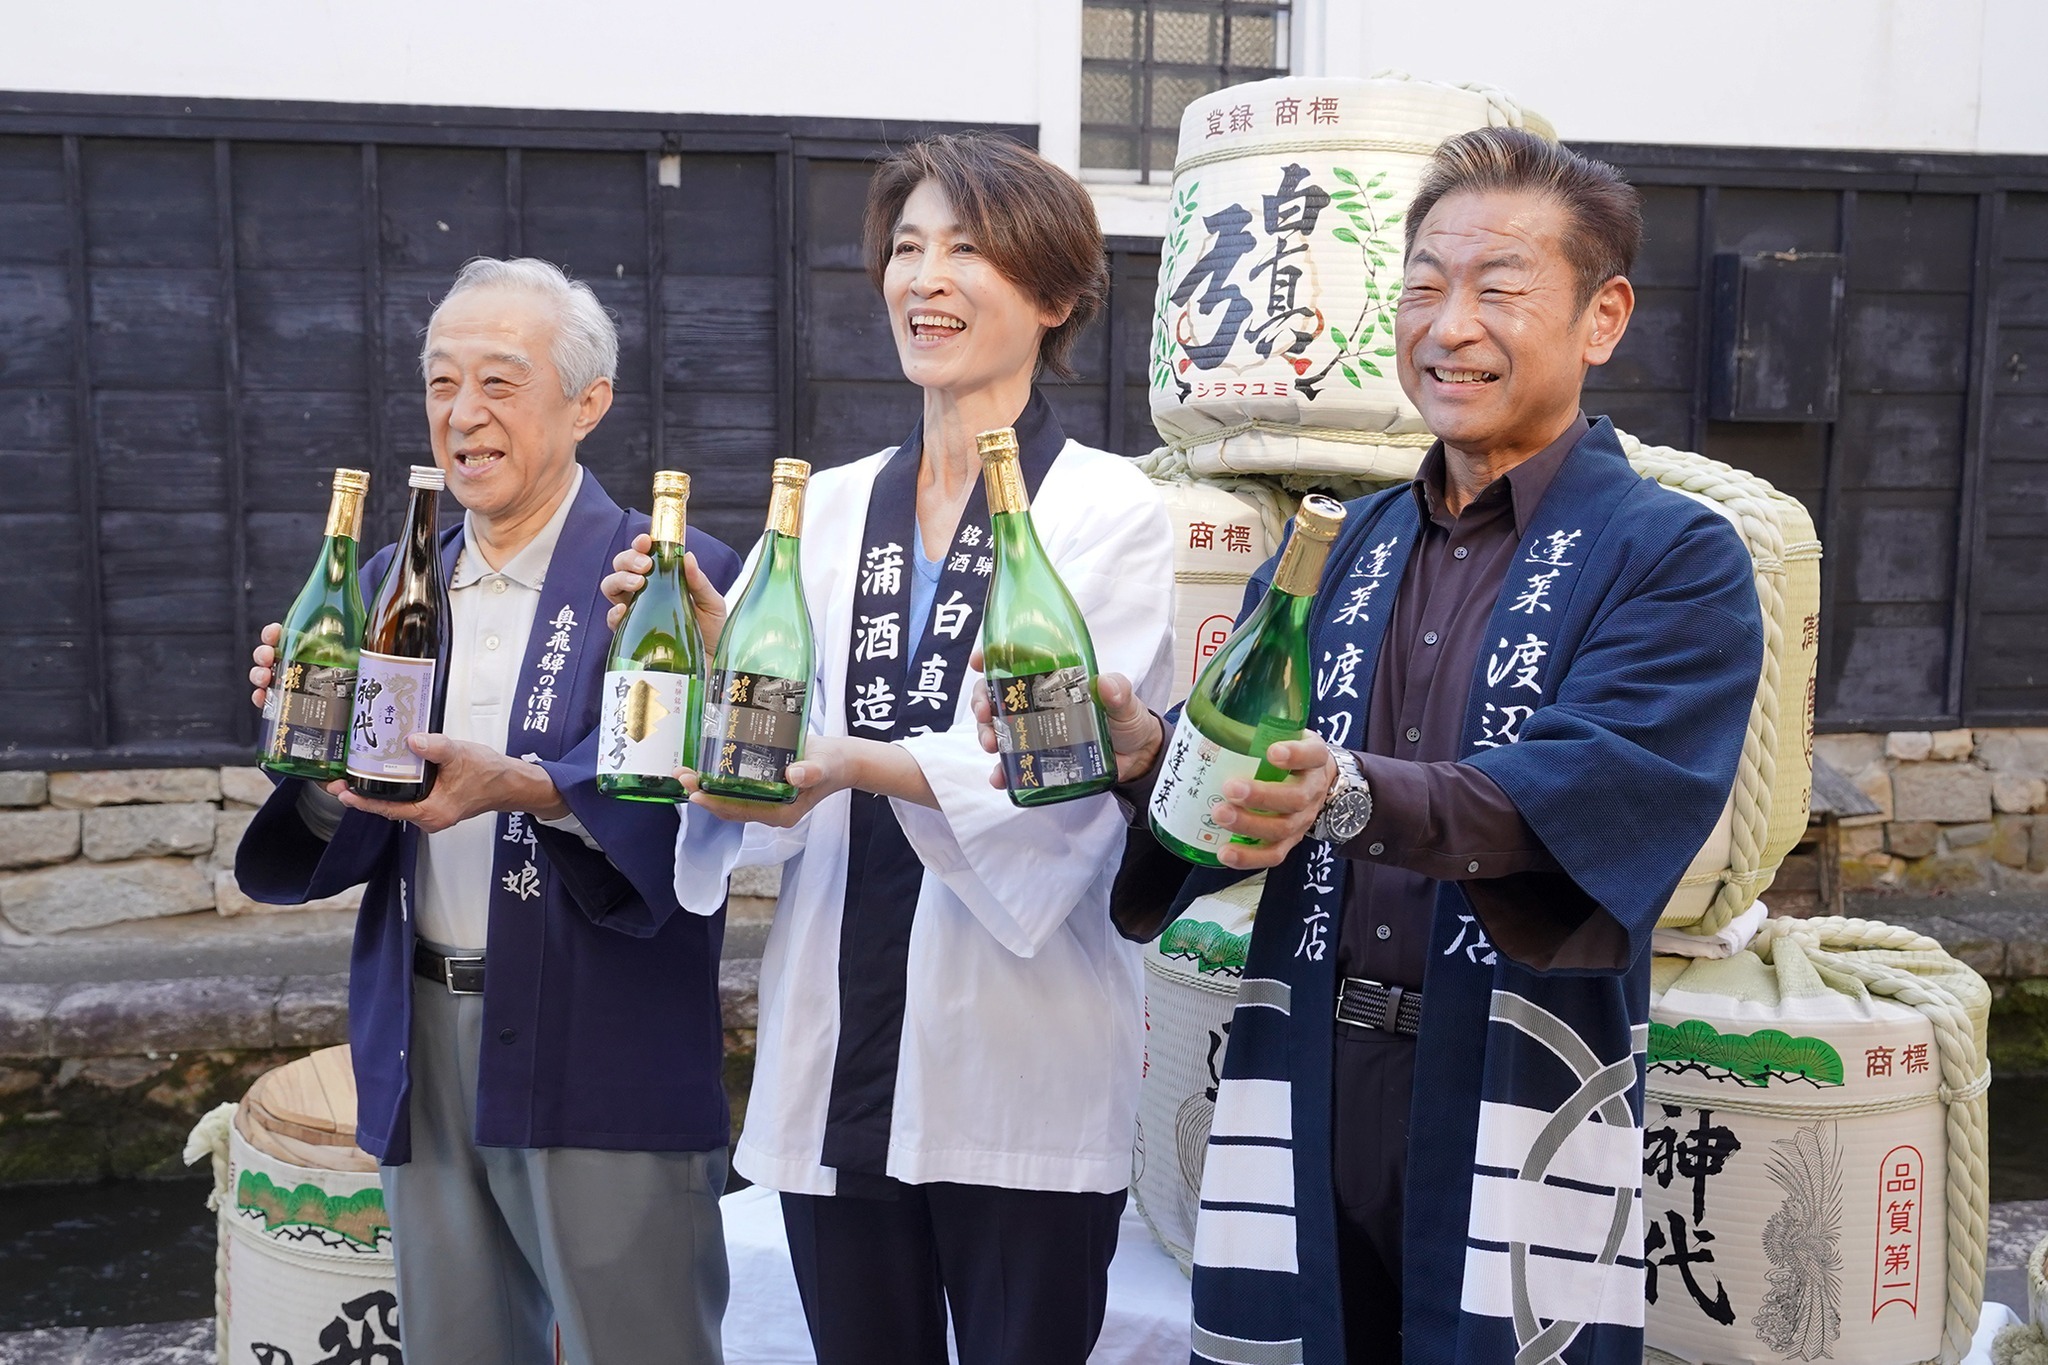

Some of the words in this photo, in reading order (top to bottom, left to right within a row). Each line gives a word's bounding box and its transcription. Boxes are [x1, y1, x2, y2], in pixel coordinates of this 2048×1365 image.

[1206, 104, 1254, 140] 登録
[1275, 96, 1340, 127] 商標
[1196, 382, 1289, 398] シラマユミ
[948, 524, 980, 574] 銘酒
[1188, 521, 1252, 554] 商標
[851, 542, 904, 730] 蒲酒造
[523, 604, 578, 733] 奥飛騨の清酒
[905, 590, 973, 738] 白真
[353, 677, 383, 749] 神代
[384, 705, 395, 725] 辛口
[608, 676, 631, 771] 白真弓
[719, 742, 737, 774] 神代
[1020, 753, 1040, 787] 神代
[1865, 1043, 1930, 1078] 商標
[1643, 1104, 1742, 1326] 神代
[1880, 1163, 1918, 1288] 品質第一
